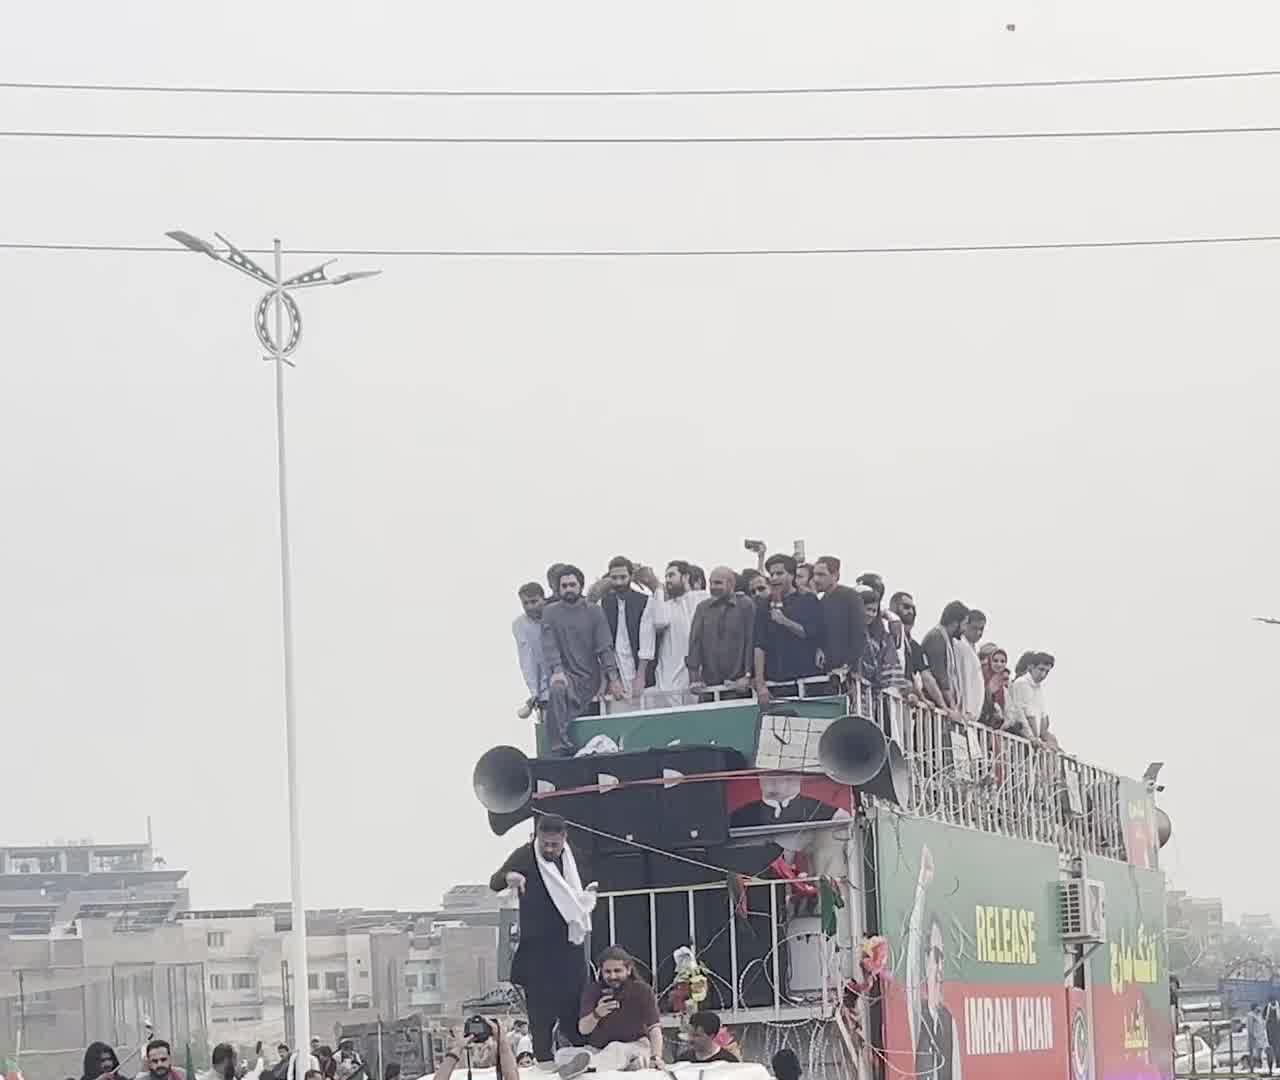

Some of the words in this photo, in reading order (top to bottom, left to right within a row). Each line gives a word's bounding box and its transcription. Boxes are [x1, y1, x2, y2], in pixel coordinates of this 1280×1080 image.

[975, 904, 1037, 964] RELEASE
[964, 996, 1014, 1055] IMRAN
[1016, 995, 1053, 1053] KHAN
